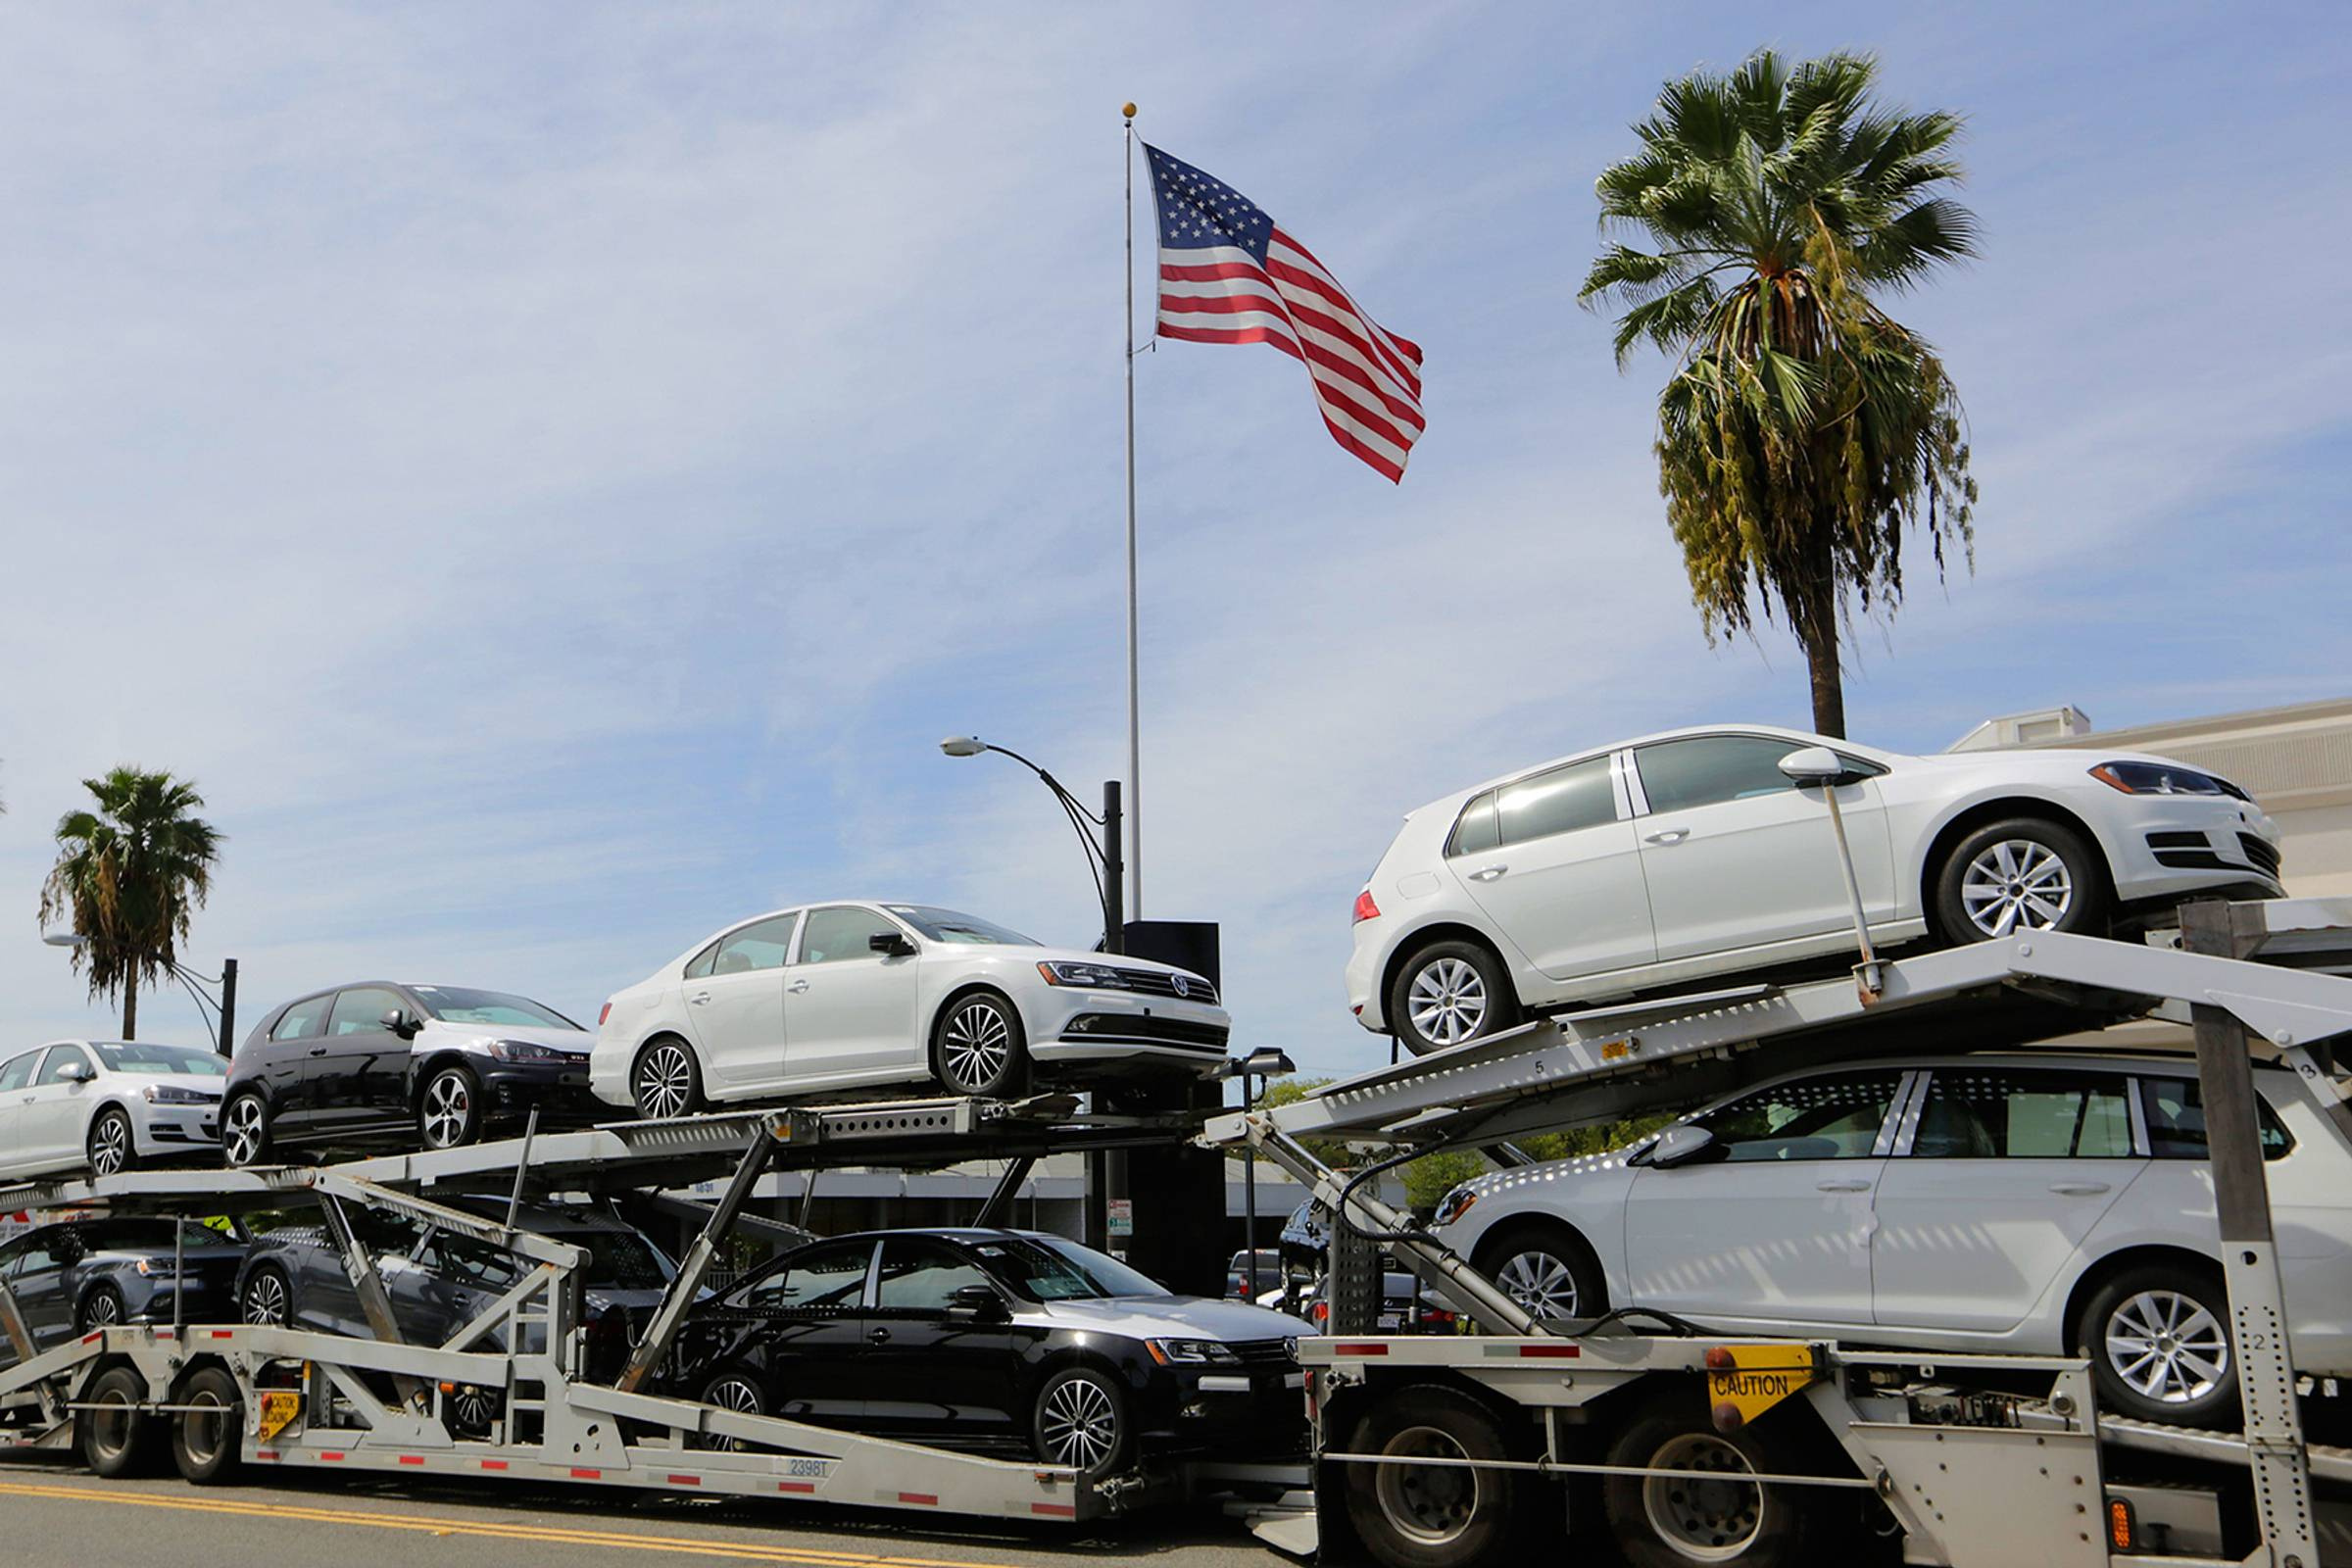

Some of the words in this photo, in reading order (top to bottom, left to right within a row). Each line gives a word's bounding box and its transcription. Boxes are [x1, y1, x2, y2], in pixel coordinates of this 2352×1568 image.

[1535, 1060, 1544, 1074] 5
[2301, 1064, 2316, 1079] 3
[2254, 1334, 2265, 1349] 2
[1715, 1375, 1788, 1396] CAUTION
